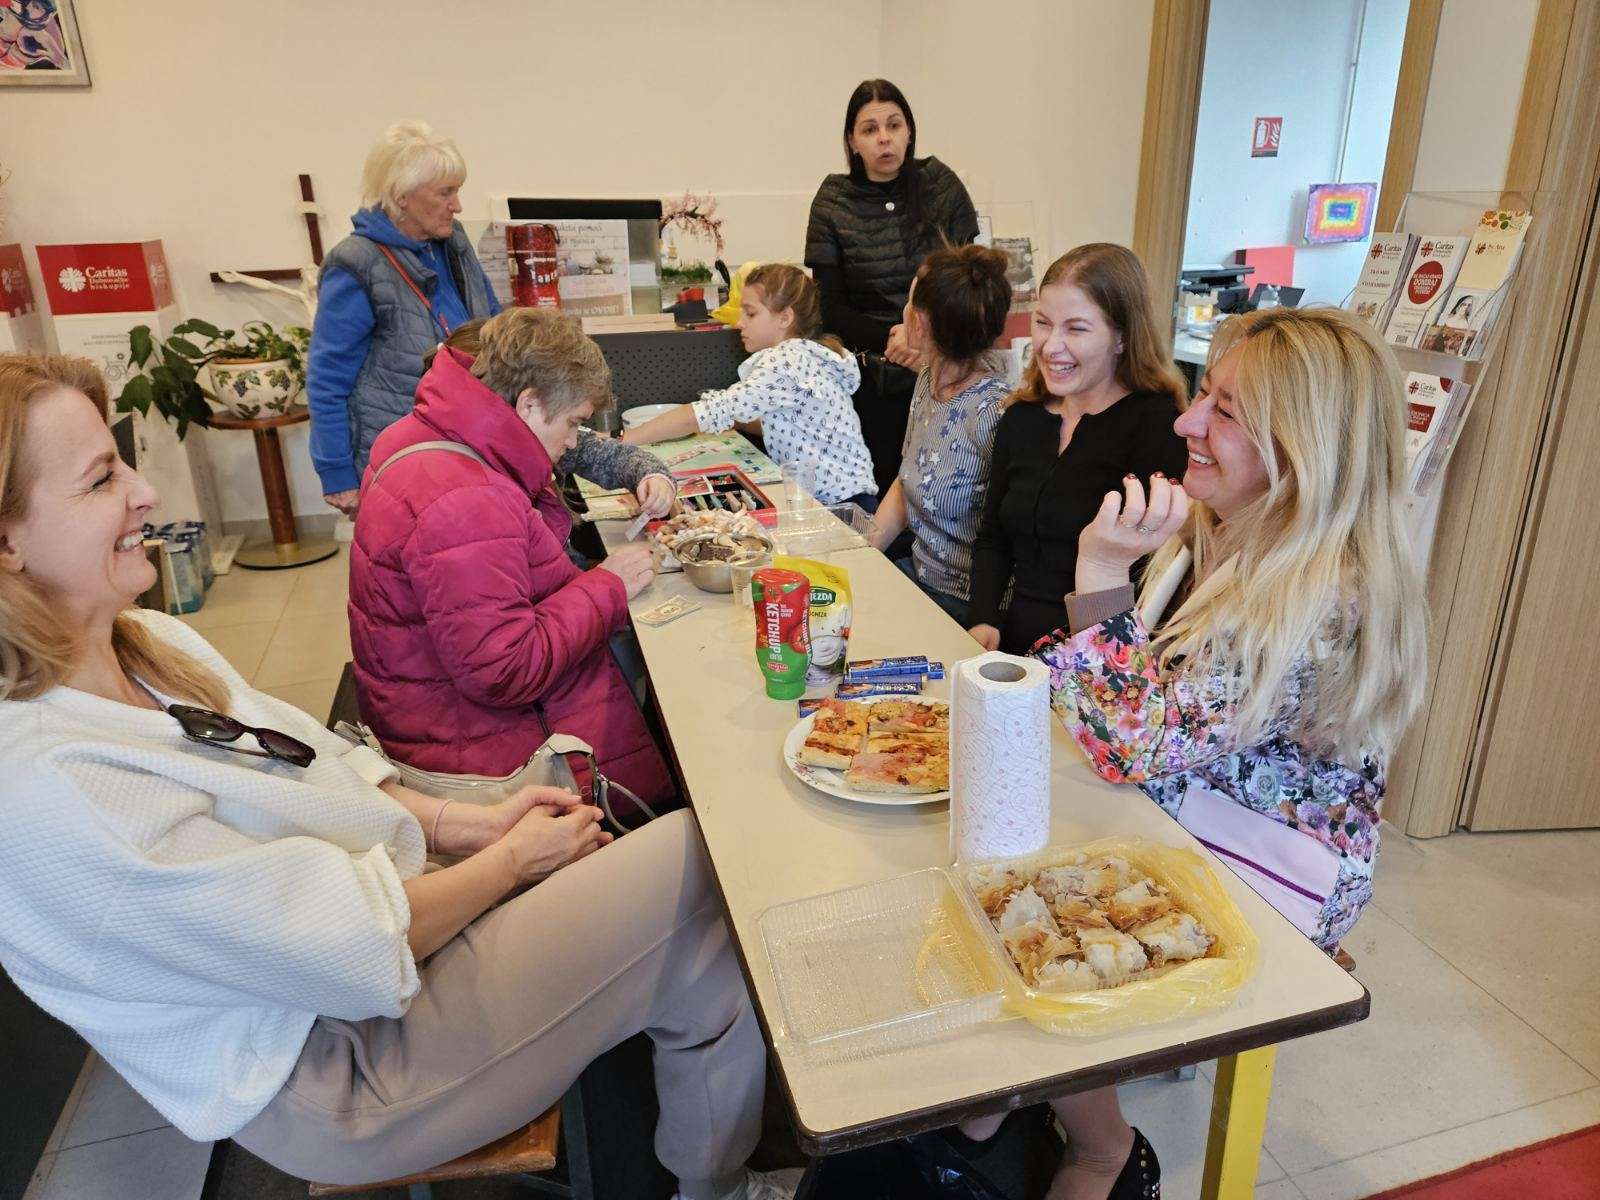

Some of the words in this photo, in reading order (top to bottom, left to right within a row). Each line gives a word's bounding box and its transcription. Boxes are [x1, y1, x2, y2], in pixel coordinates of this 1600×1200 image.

[1435, 241, 1454, 250] Caritas
[85, 266, 128, 278] Caritas
[809, 592, 833, 602] JEZDA
[766, 602, 781, 653] KETCHUP
